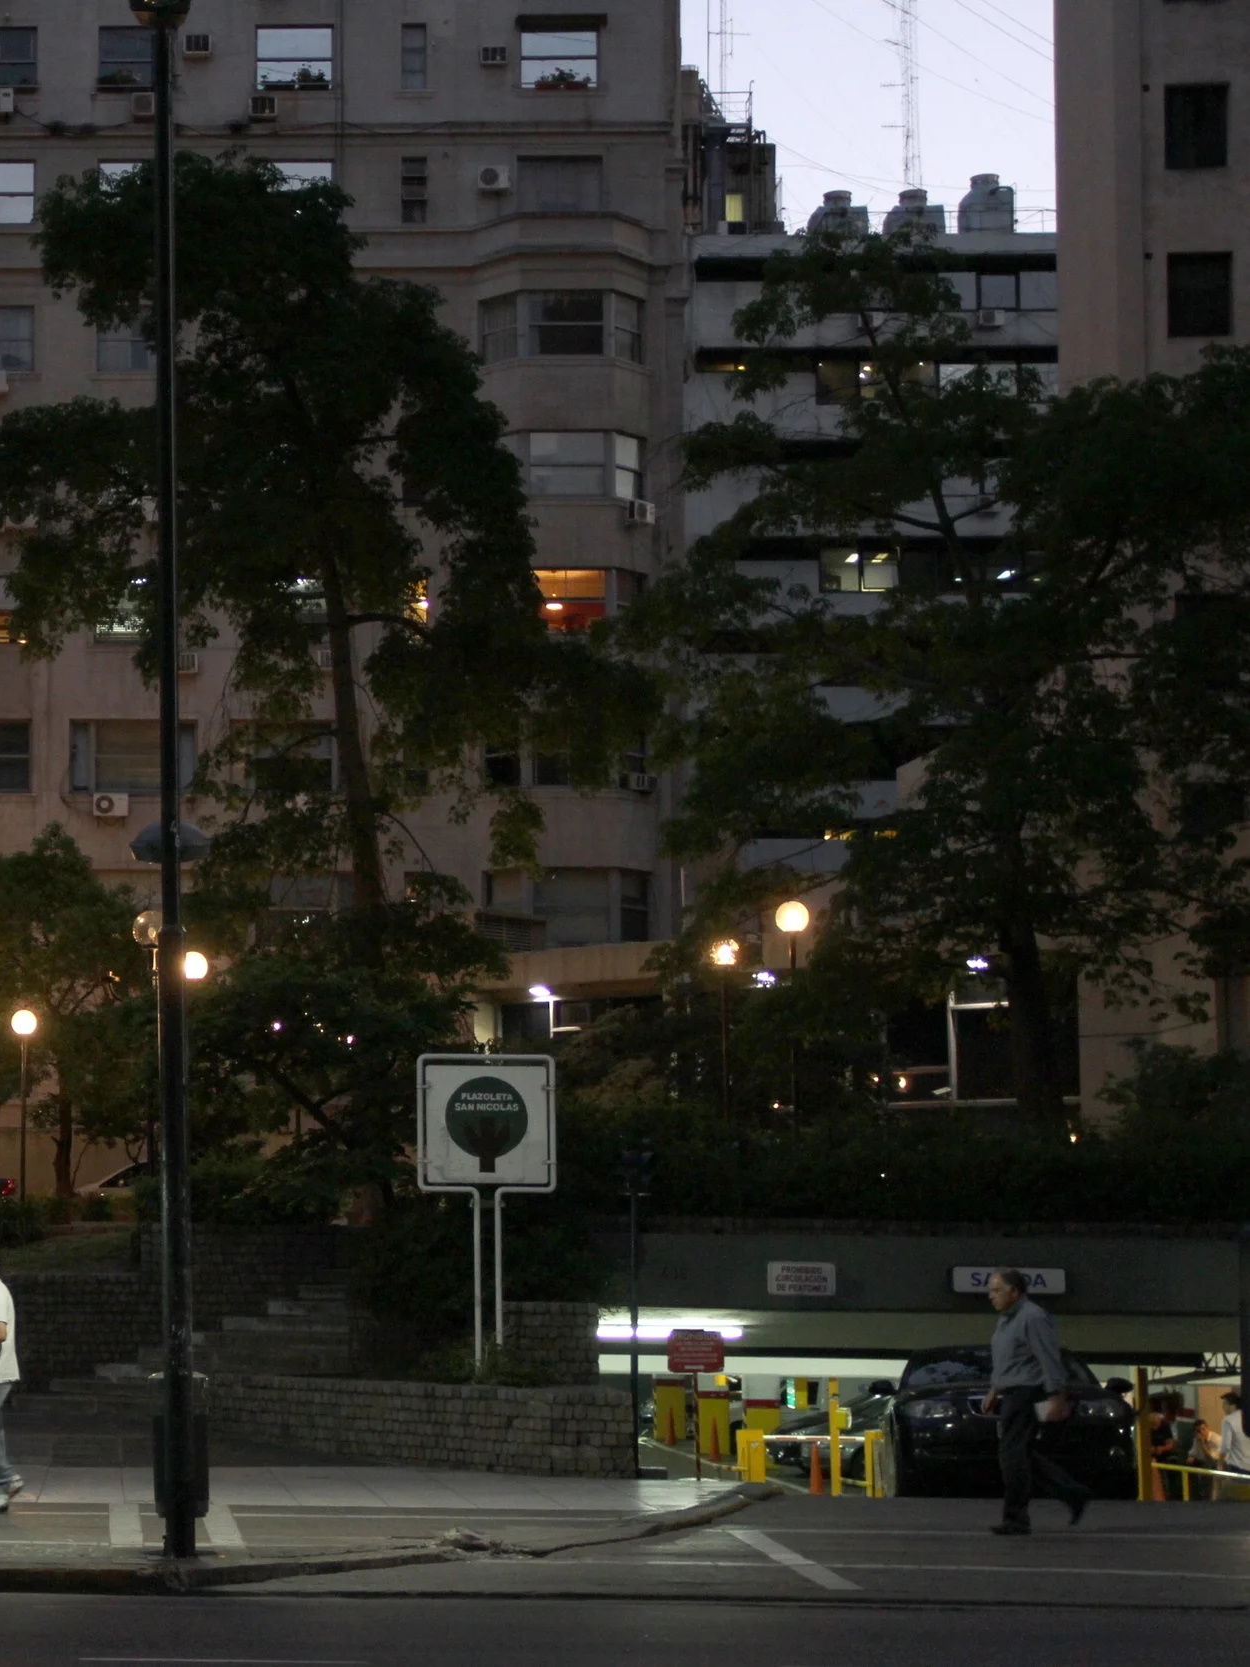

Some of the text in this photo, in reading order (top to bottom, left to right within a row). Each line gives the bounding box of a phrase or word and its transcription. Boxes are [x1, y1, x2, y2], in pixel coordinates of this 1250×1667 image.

[461, 1092, 513, 1101] PLAZOLETA
[454, 1102, 519, 1111] SAN NICOLAS
[970, 1271, 1047, 1288] SADA
